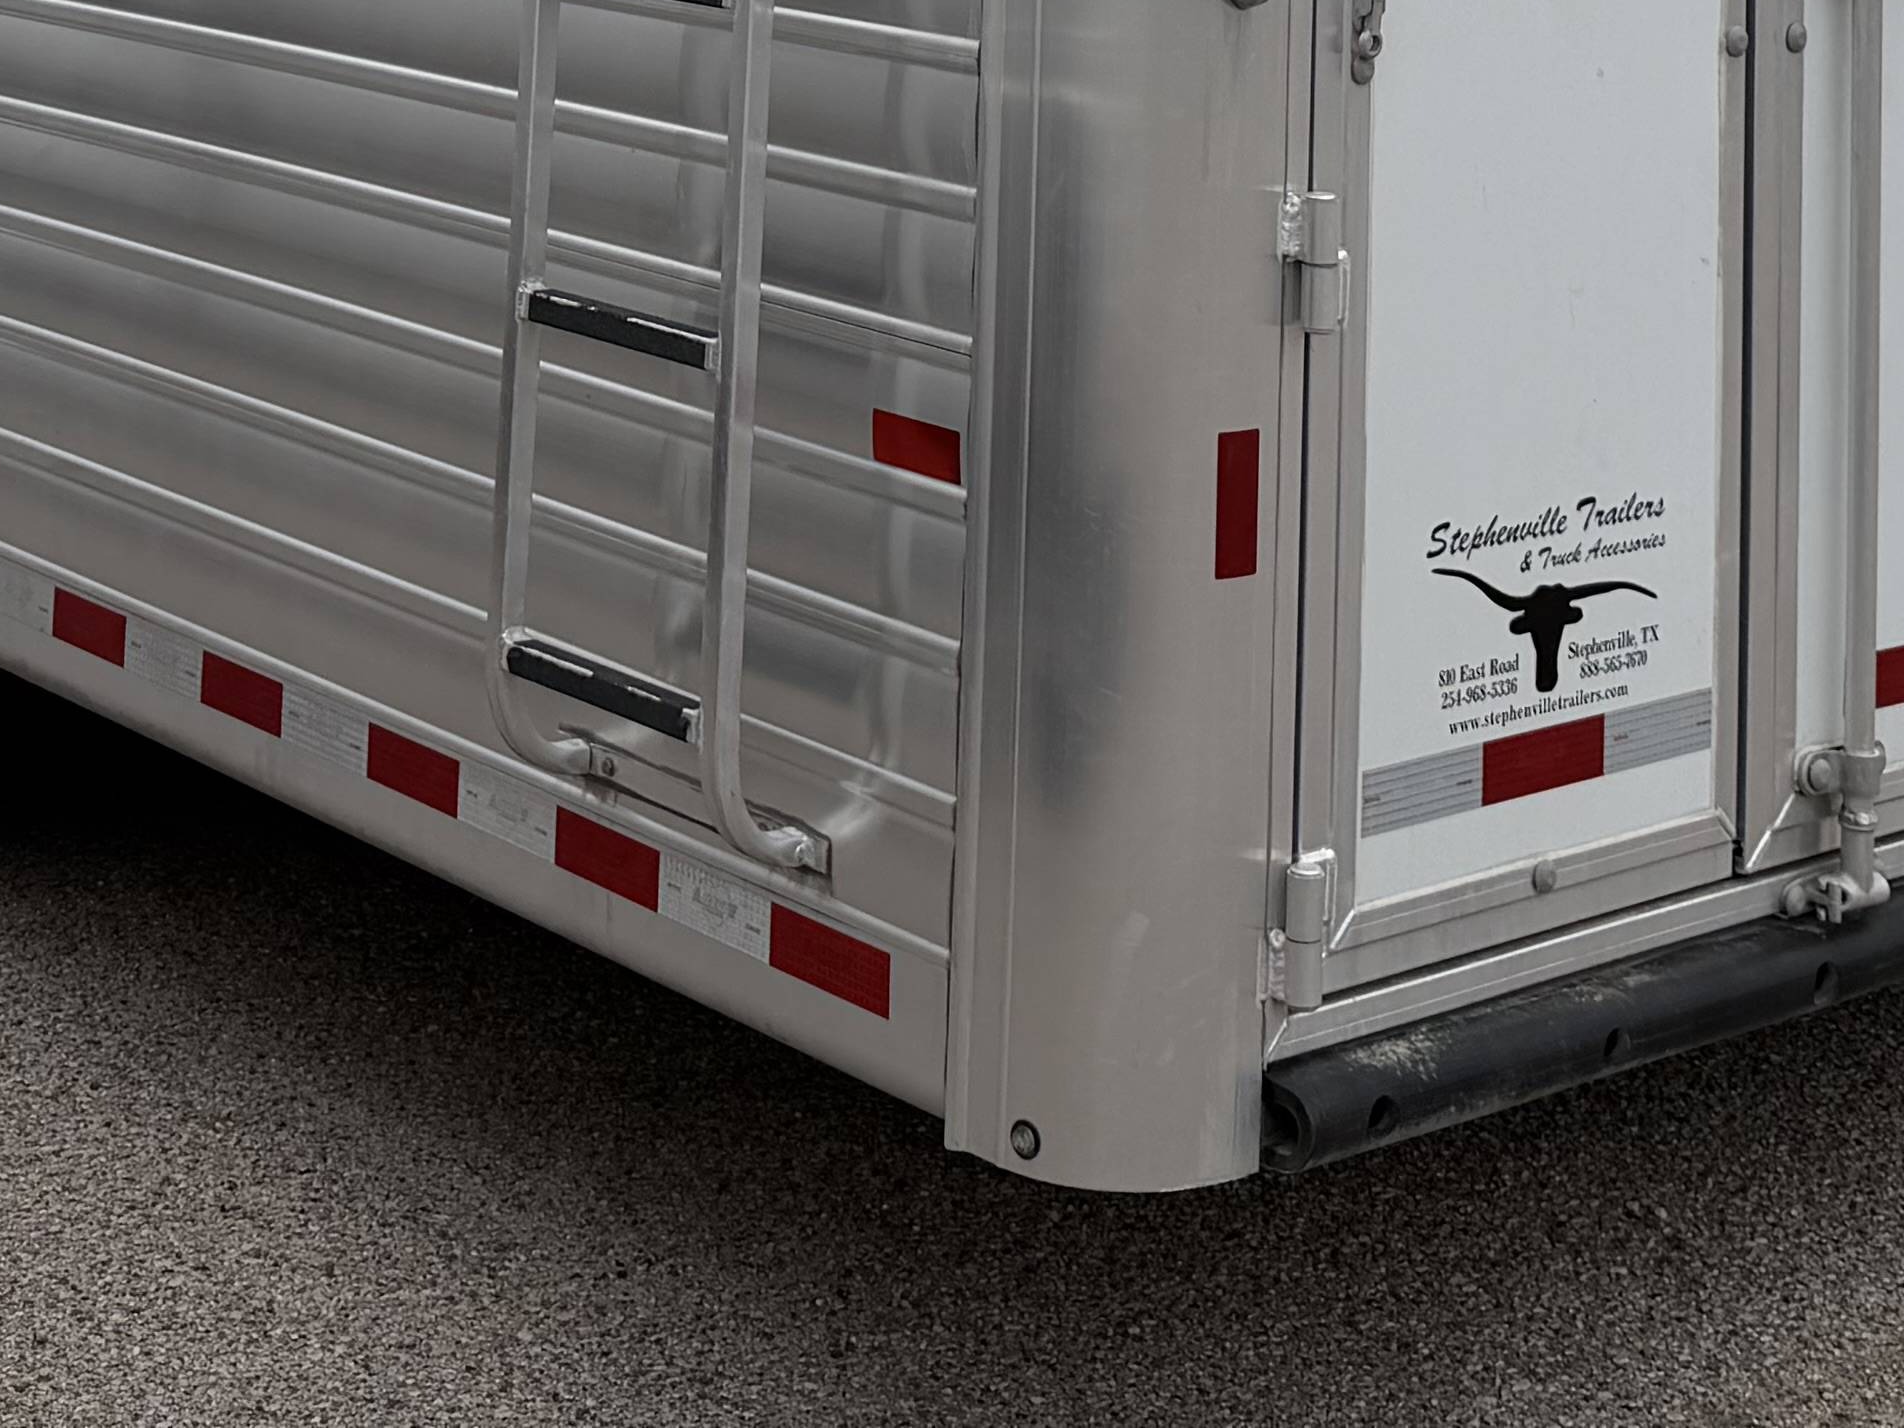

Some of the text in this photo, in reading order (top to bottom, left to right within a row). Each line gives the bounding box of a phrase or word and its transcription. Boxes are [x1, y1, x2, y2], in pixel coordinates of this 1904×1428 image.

[1426, 491, 1666, 561] Stephenville Trailers
[1519, 532, 1667, 573] & Truck Accessories
[1567, 624, 1660, 660] Stephenville, TX
[1460, 662, 1486, 683] East
[1490, 653, 1520, 676] Road
[1449, 683, 1630, 735] www.stephenvilletrailers.com
